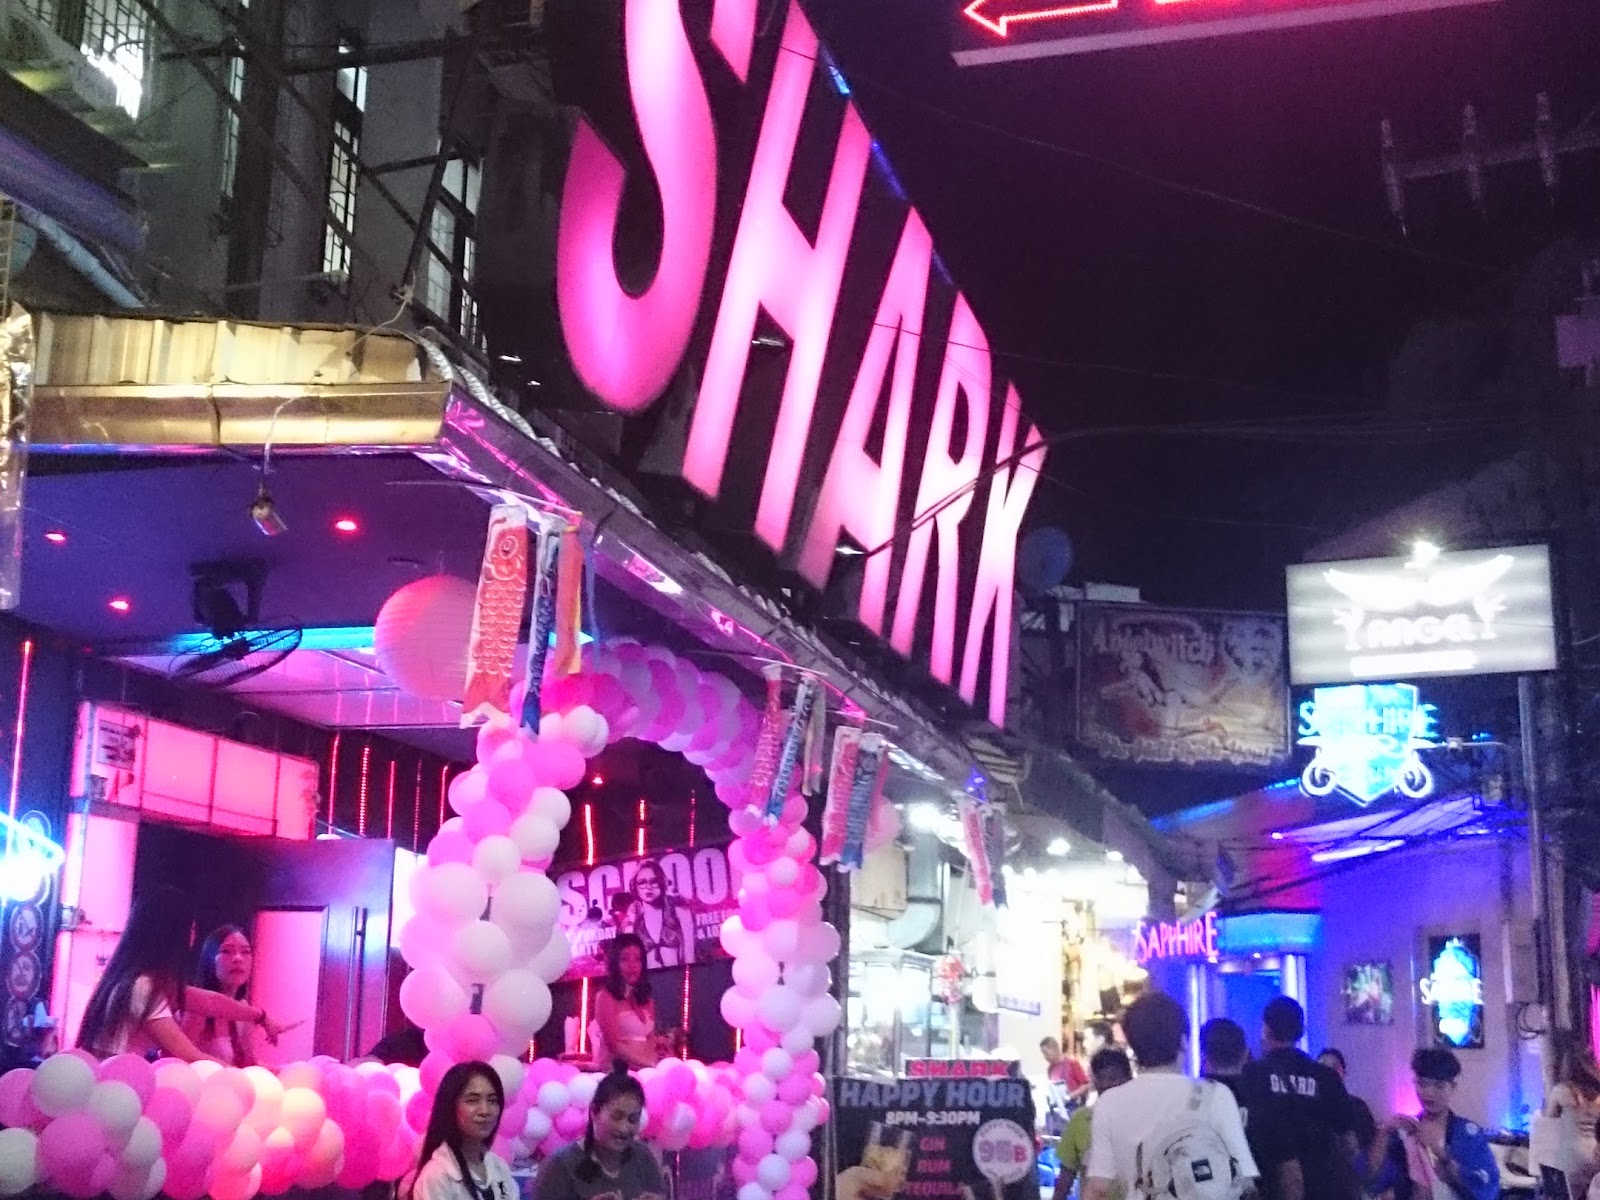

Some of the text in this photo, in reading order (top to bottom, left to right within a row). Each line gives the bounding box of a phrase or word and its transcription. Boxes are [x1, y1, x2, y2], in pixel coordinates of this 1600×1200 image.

[557, 0, 1048, 730] SHARK
[1131, 911, 1219, 963] SAPPHIRE
[909, 1060, 1009, 1077] SHARK
[839, 1080, 1025, 1108] HAPPY HOUR
